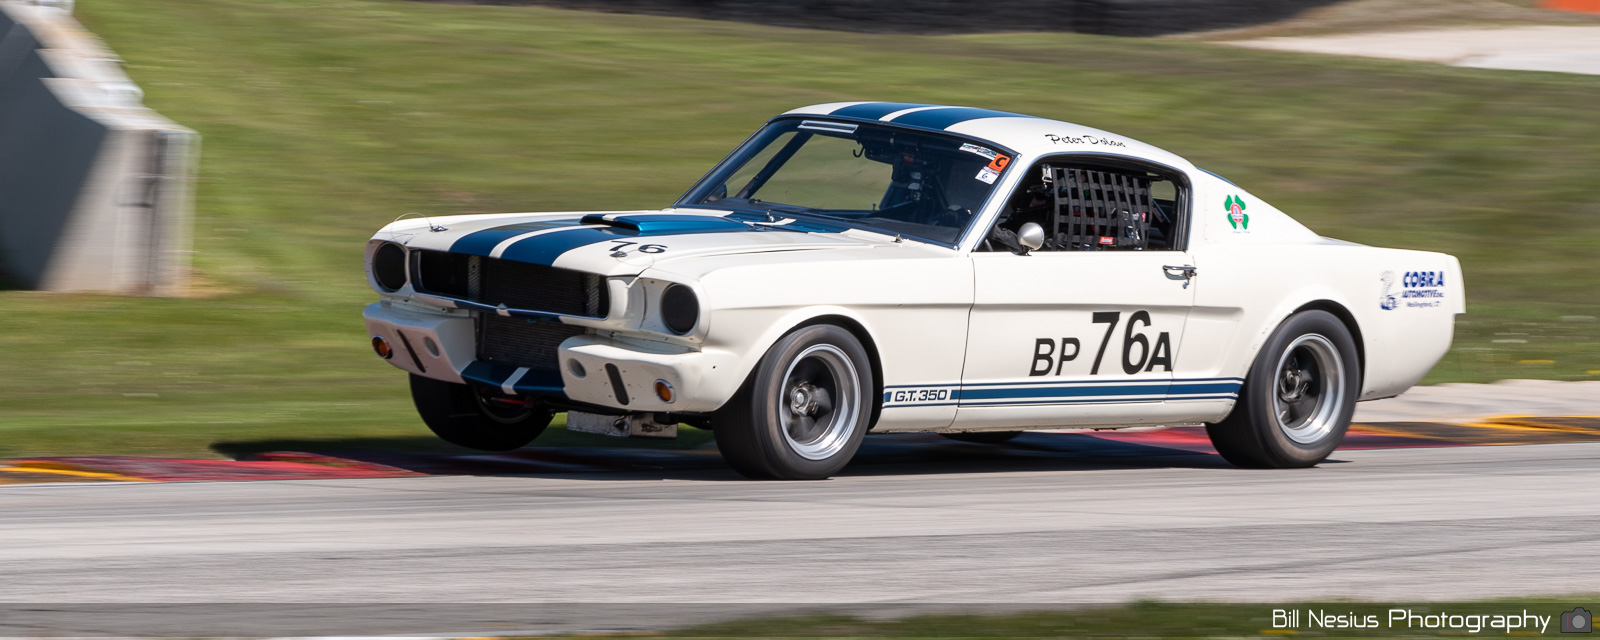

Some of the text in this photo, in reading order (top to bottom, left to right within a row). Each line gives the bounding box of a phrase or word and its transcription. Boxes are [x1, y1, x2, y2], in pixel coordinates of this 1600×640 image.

[1044, 134, 1126, 147] Peter Dolan
[609, 240, 669, 254] 76
[1403, 271, 1444, 287] COBRA
[1028, 337, 1081, 377] BP
